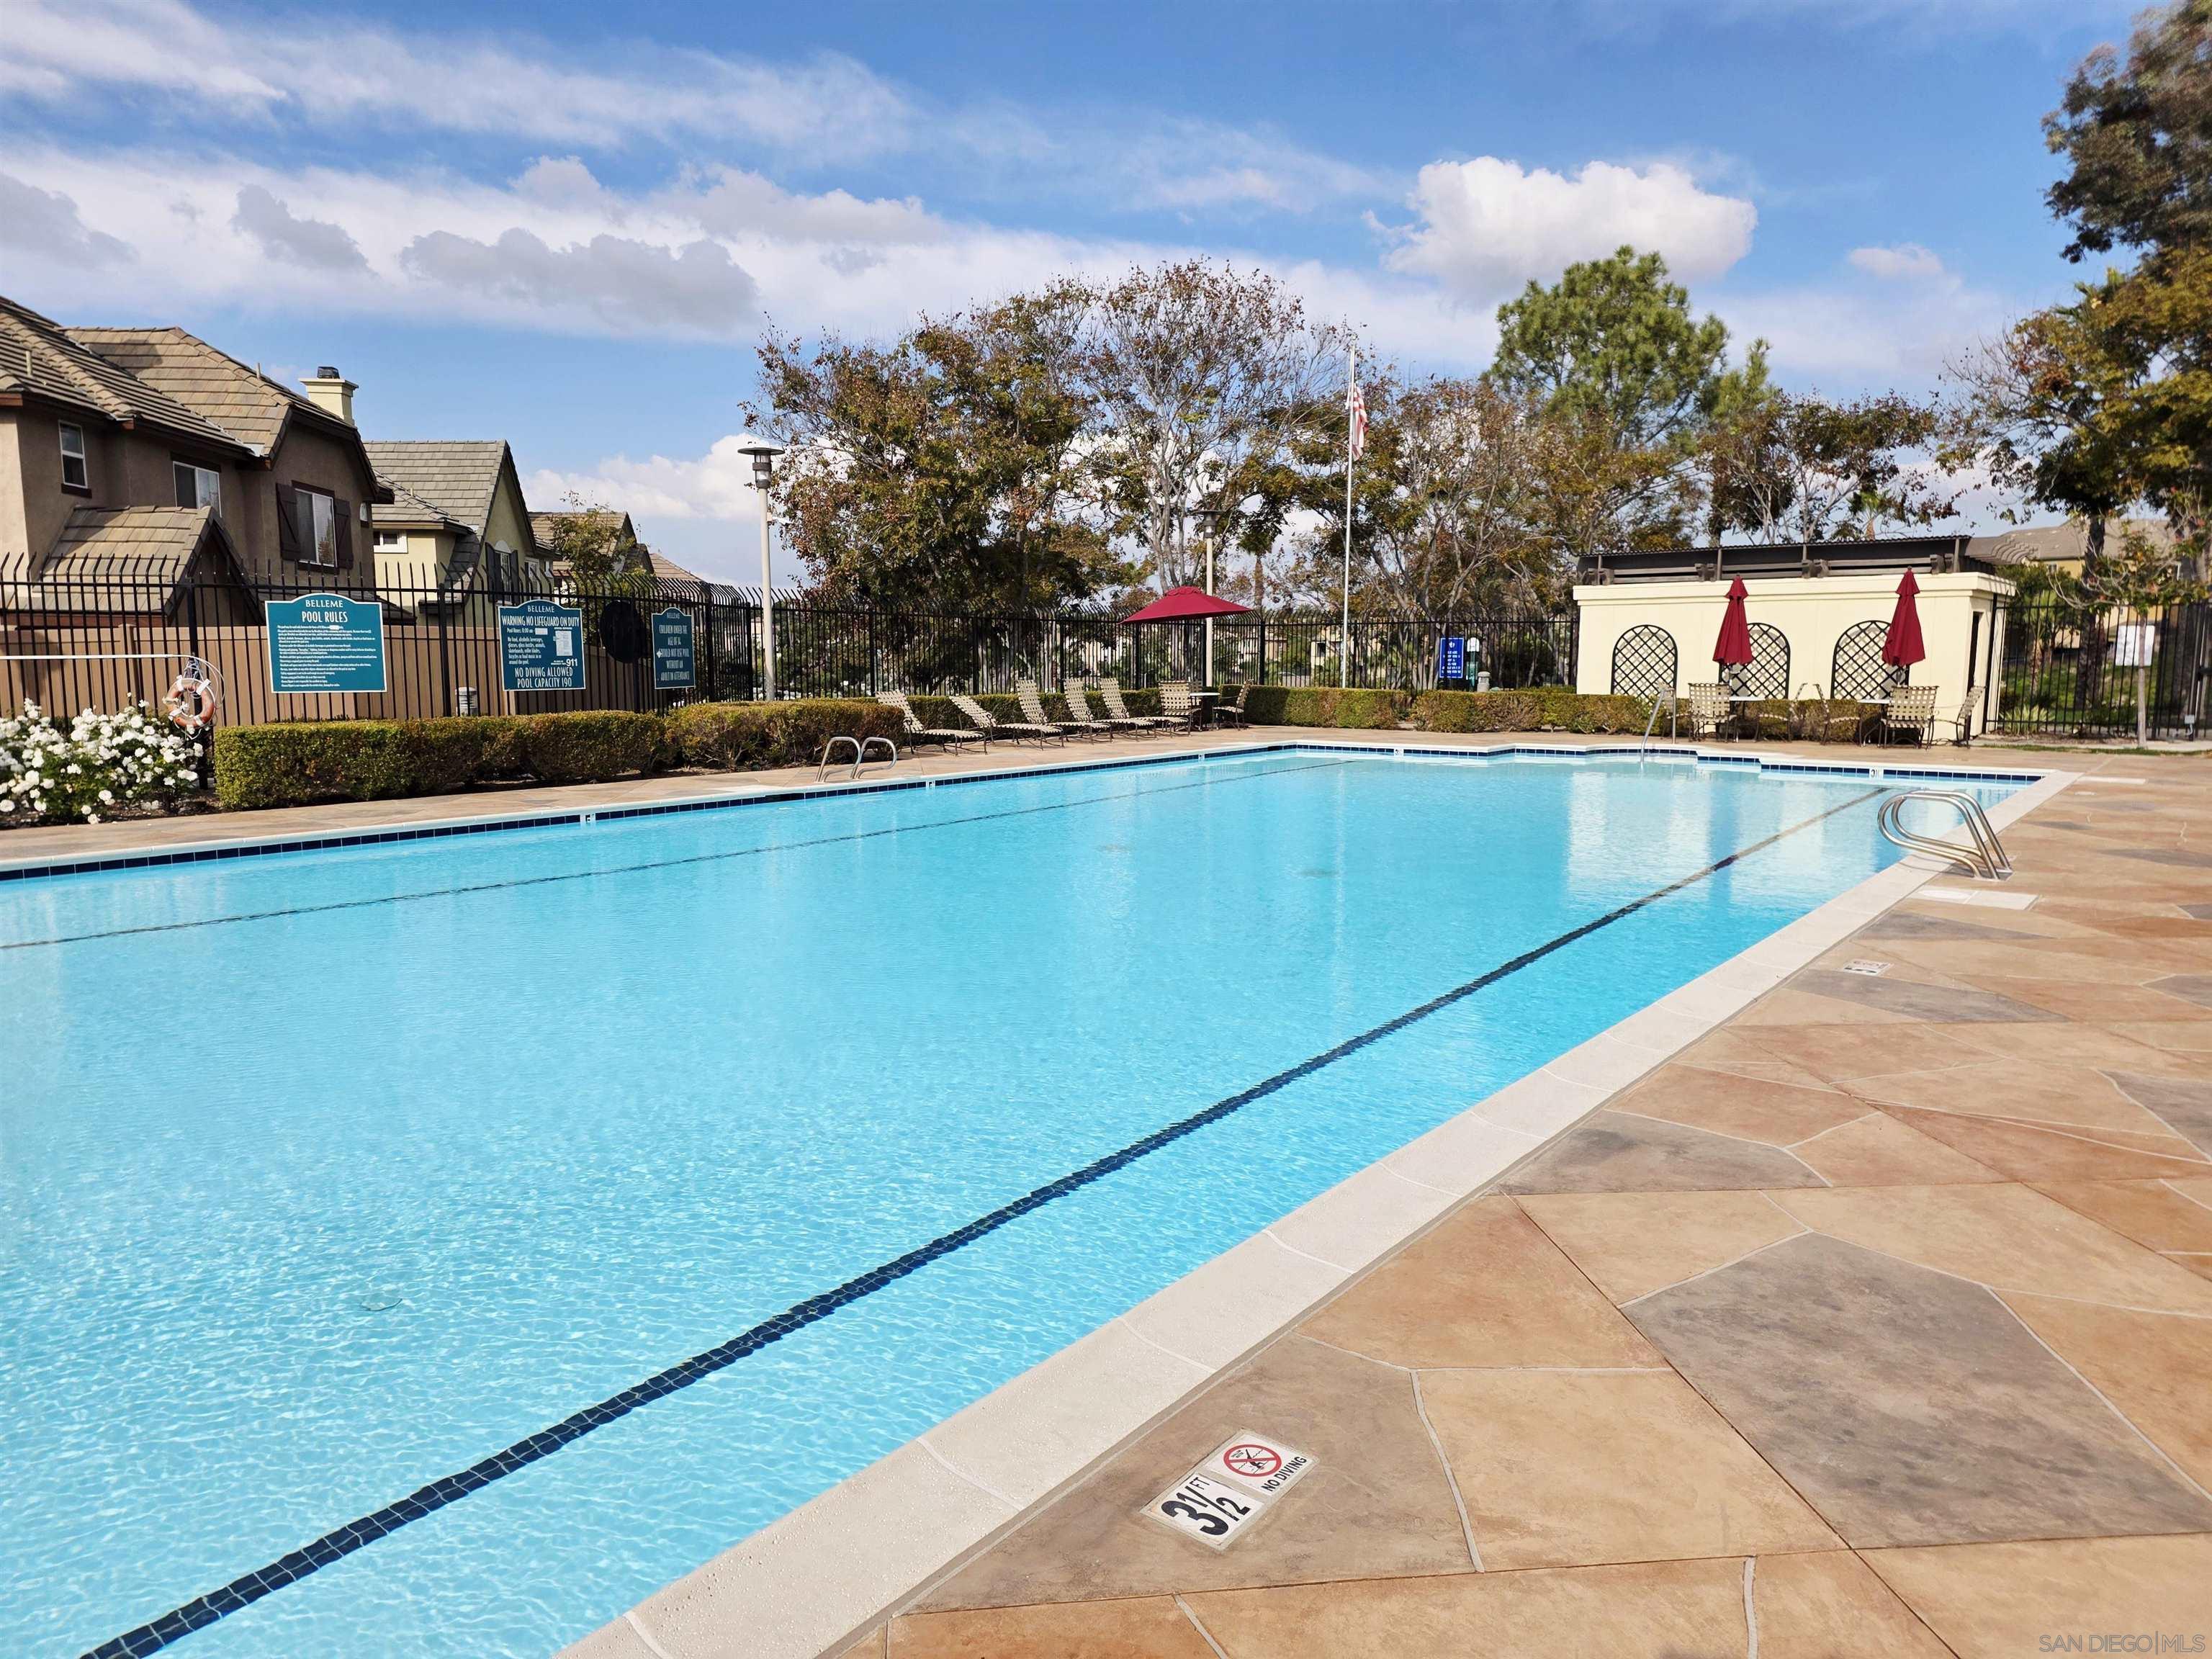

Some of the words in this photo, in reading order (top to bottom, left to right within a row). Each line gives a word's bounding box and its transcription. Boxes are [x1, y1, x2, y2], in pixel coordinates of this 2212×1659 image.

[305, 599, 343, 608] BELLEME
[302, 611, 323, 623] POOL
[325, 611, 348, 623] RULES
[501, 615, 526, 626] WARNING
[526, 616, 534, 626] NO
[534, 616, 559, 627] LIFEGUARD
[559, 616, 567, 626] ON
[567, 616, 580, 627] DUTY
[566, 658, 578, 667] 911
[515, 667, 524, 678] NO
[526, 667, 546, 678] DIVING
[547, 667, 573, 677] ALLOWED
[517, 678, 533, 688] POOL
[534, 678, 560, 688] CAPACITY
[562, 677, 572, 687] 190
[1261, 1473, 1281, 1493] NO
[1278, 1456, 1308, 1486] DIVING
[1190, 1476, 1210, 1491] FT
